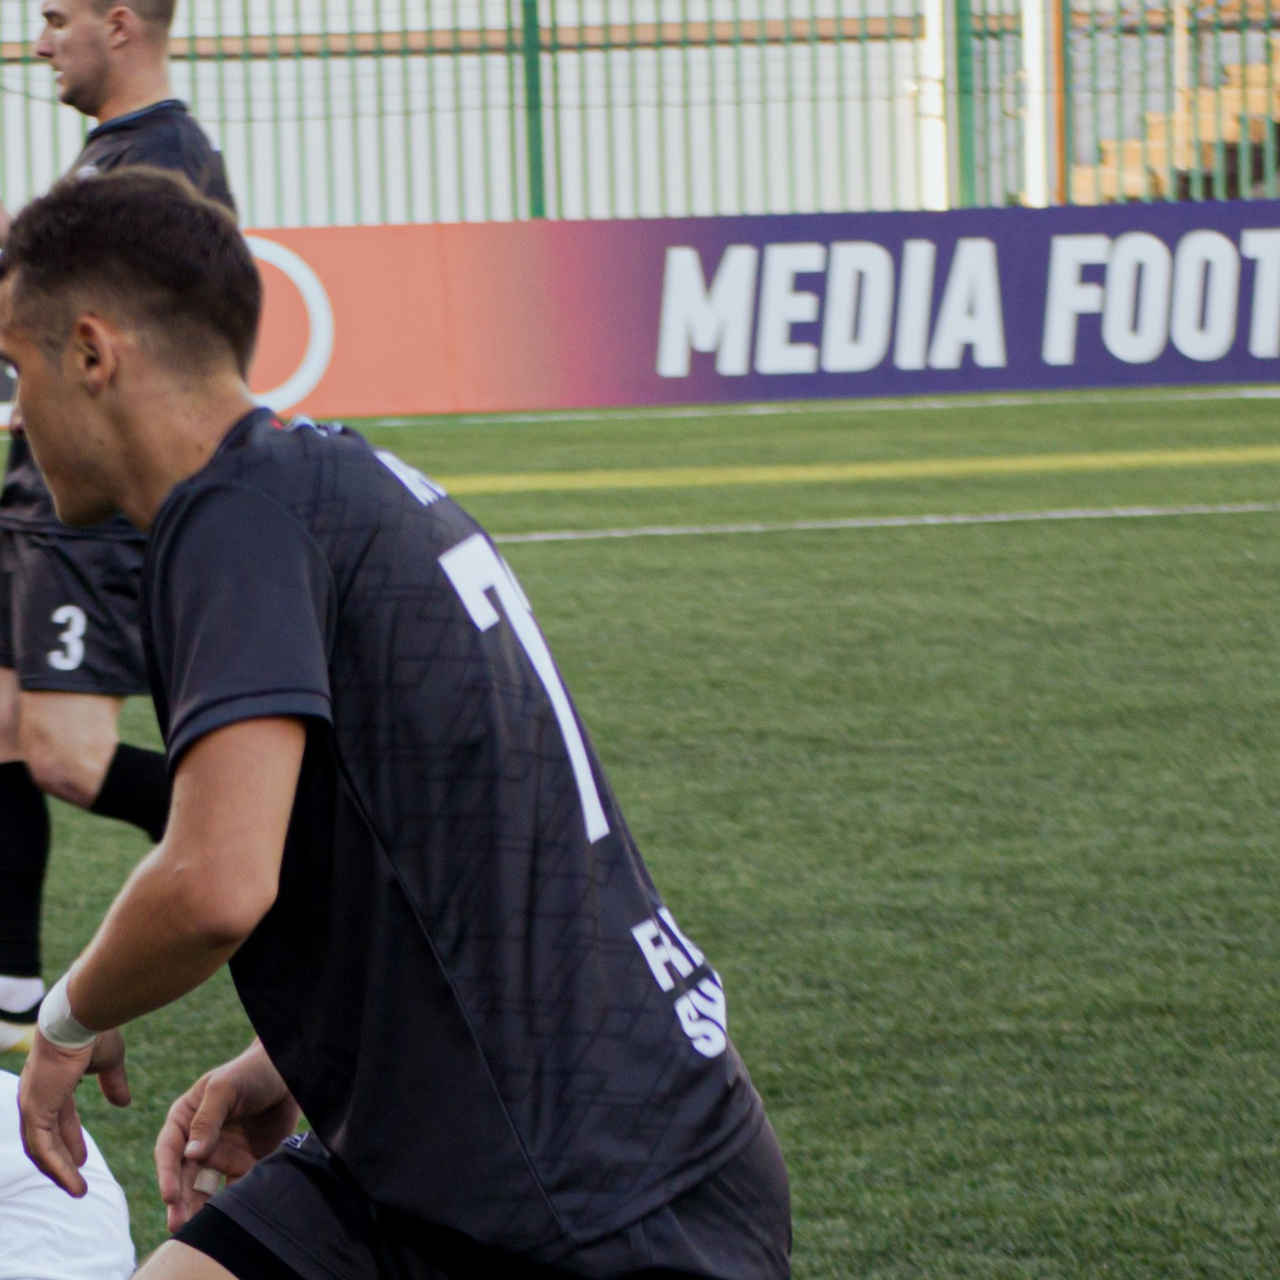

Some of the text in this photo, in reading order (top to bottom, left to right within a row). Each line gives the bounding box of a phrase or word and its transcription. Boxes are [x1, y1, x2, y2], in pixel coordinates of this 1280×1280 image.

[655, 237, 1007, 378] MEDIA
[47, 604, 88, 672] 3
[437, 532, 610, 844] 7
